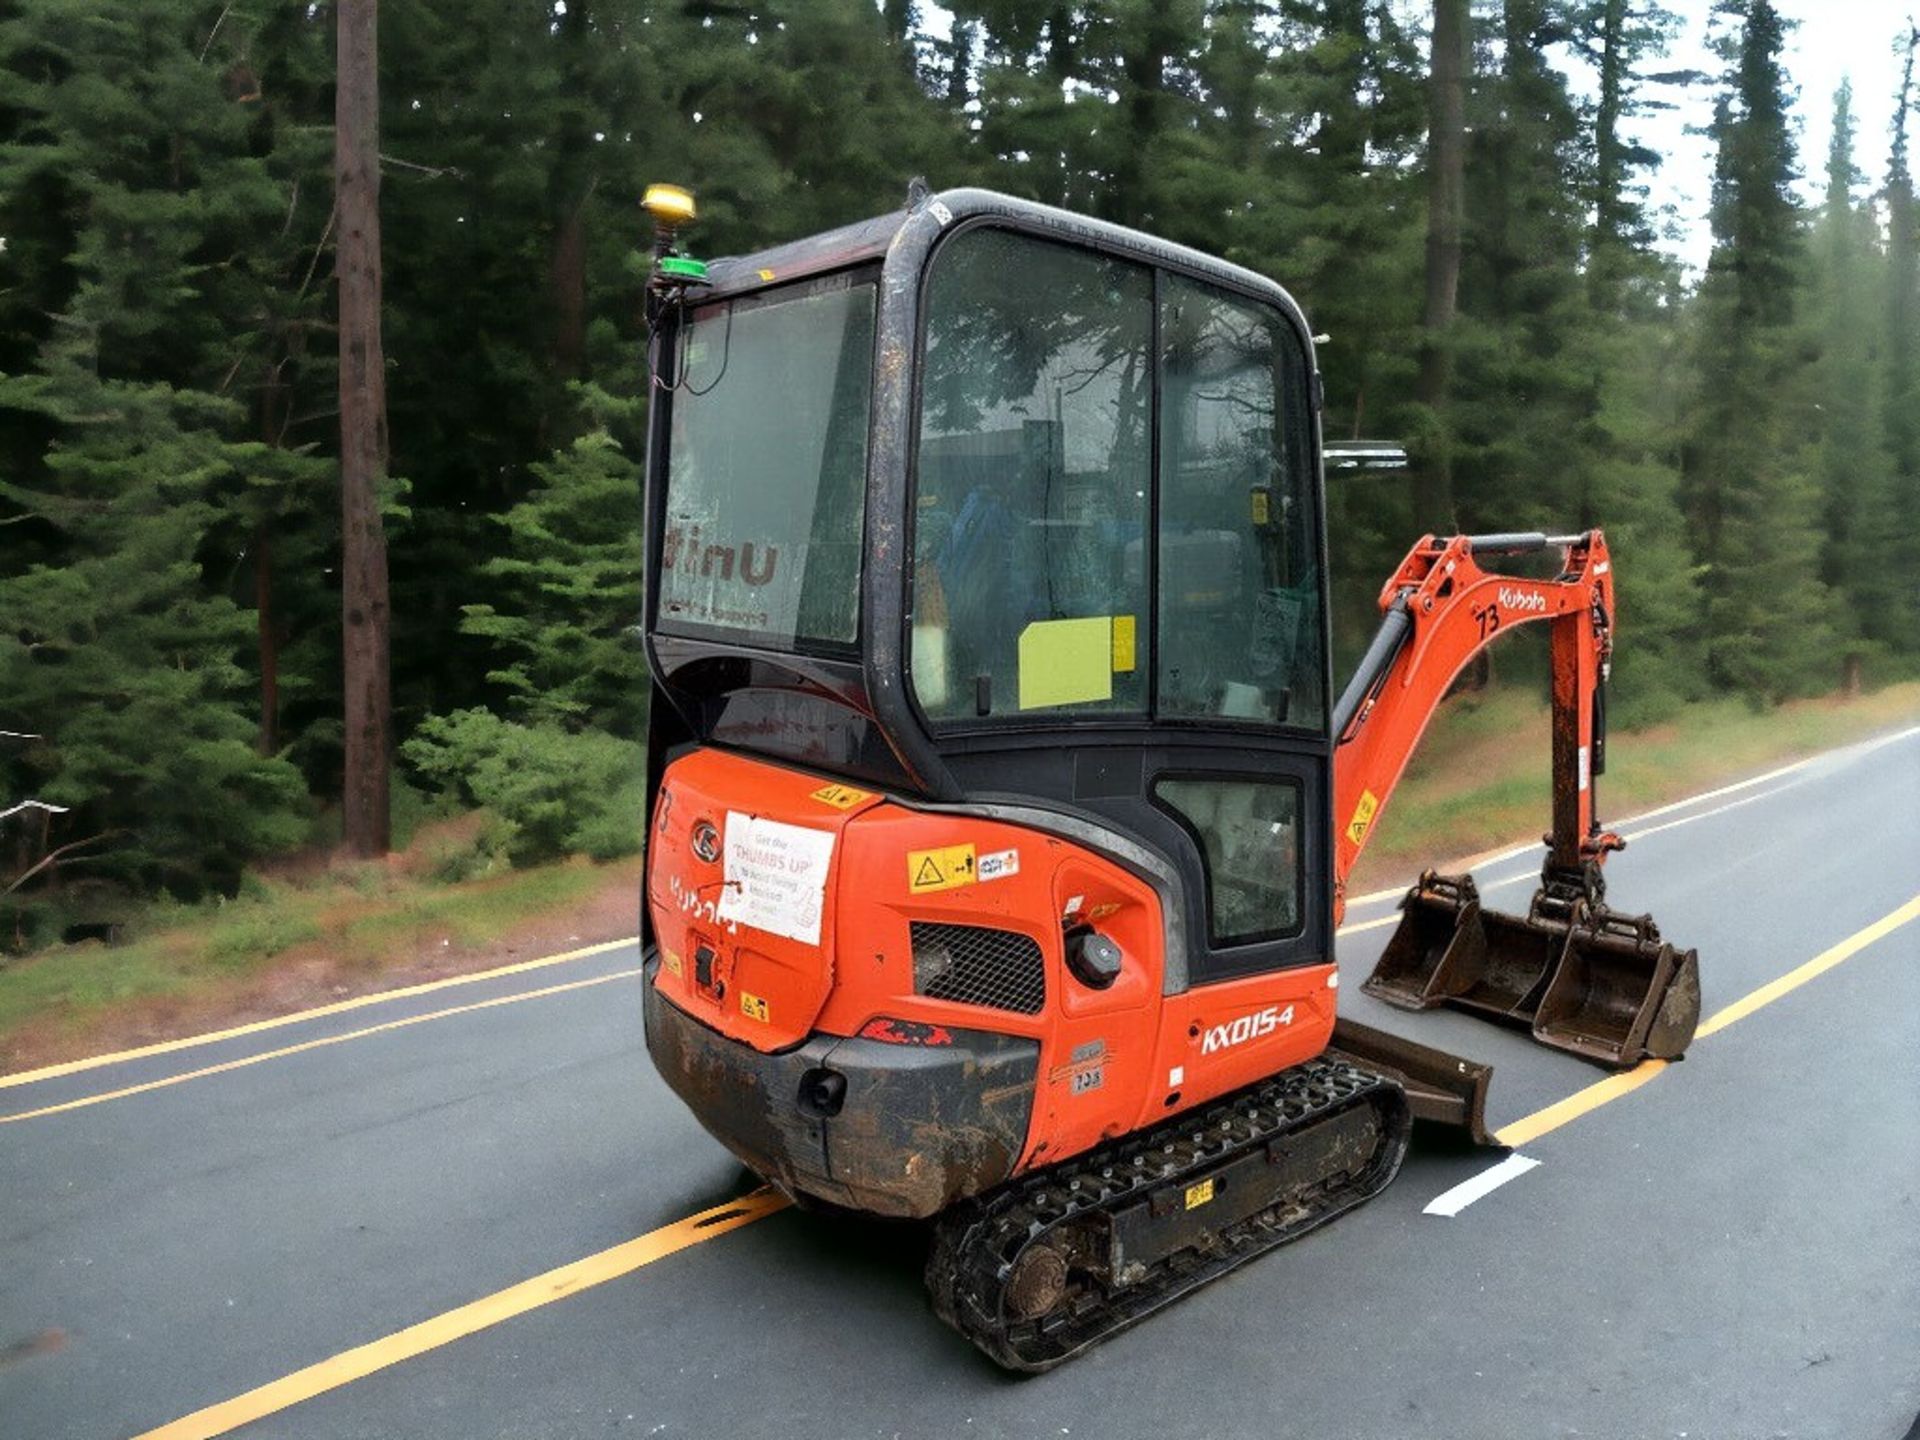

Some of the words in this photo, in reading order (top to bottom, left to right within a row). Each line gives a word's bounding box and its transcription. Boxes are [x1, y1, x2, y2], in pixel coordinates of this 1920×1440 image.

[1499, 588, 1545, 611] Kubota
[1475, 605, 1500, 640] 73
[1201, 1005, 1294, 1055] KX015-4
